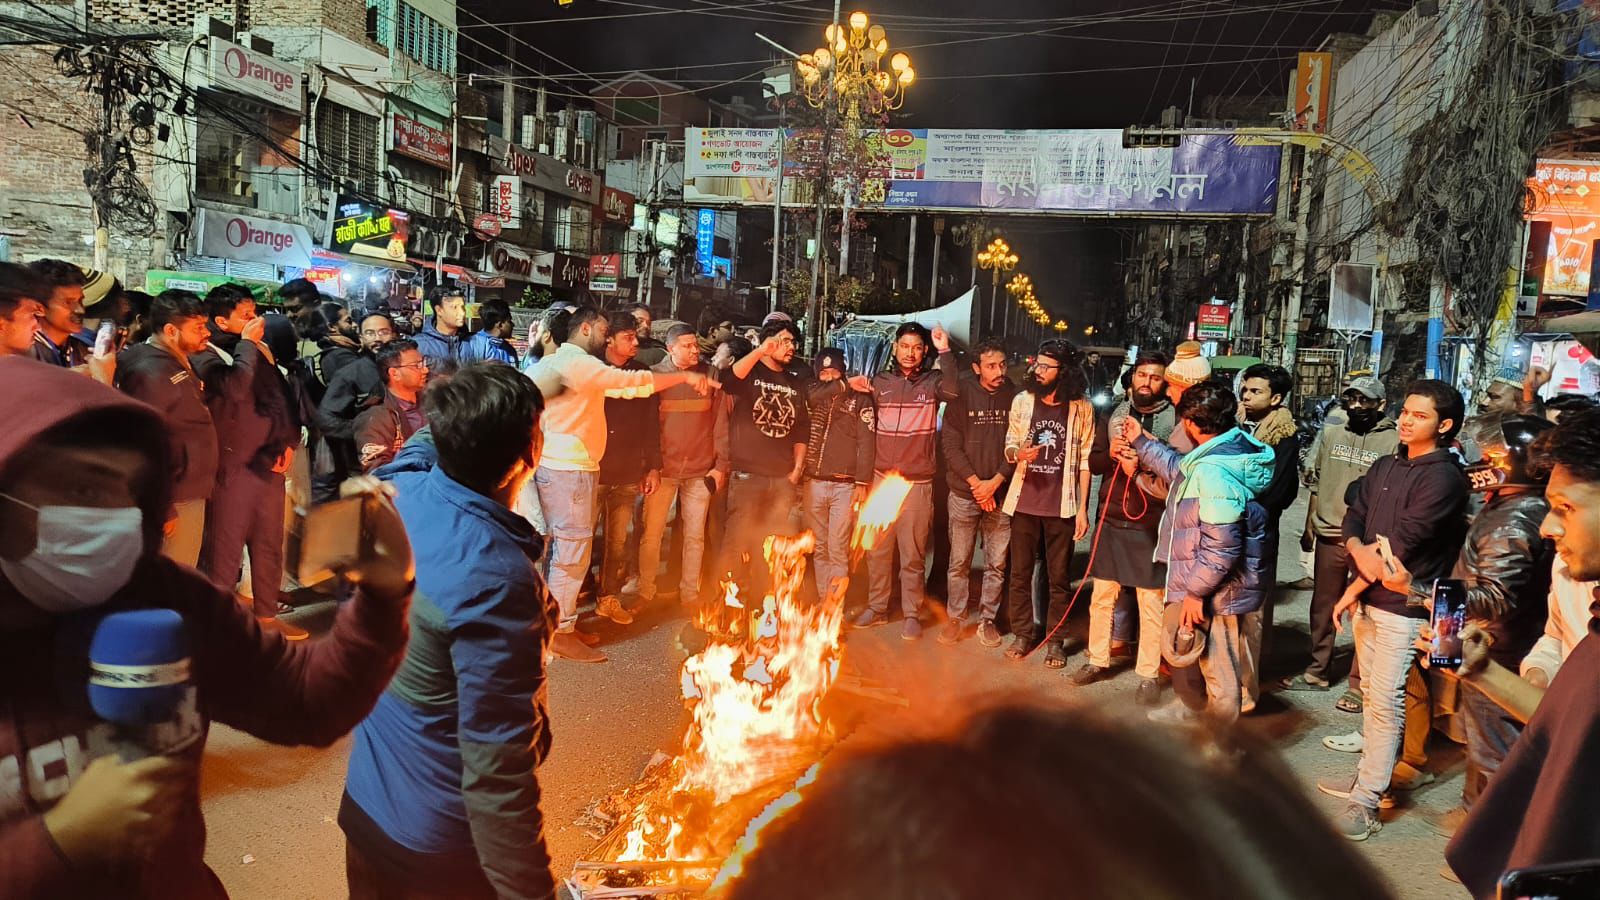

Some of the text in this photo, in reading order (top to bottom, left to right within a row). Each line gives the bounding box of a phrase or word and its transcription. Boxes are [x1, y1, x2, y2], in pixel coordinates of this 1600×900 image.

[224, 47, 294, 92] Orange
[504, 143, 536, 176] Apex
[226, 217, 294, 253] Orange
[335, 218, 357, 244] হাজী
[493, 249, 532, 277] Omni
